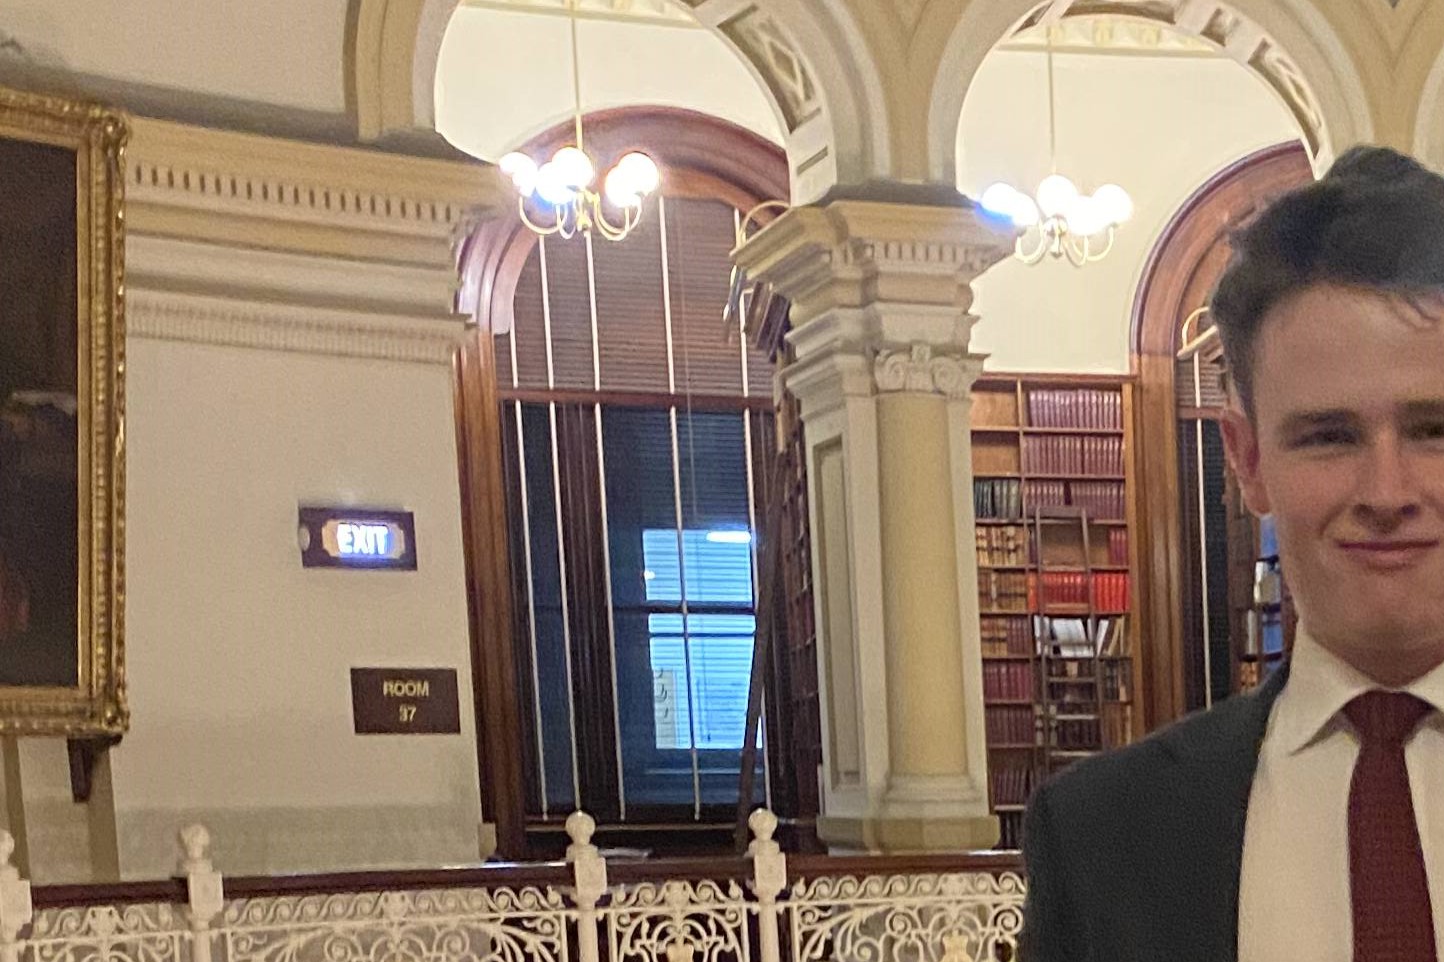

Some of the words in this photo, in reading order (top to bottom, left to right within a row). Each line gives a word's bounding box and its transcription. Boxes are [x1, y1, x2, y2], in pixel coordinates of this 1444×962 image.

[337, 523, 389, 555] EXIT
[382, 680, 430, 698] ROOM
[399, 705, 417, 722] 37
